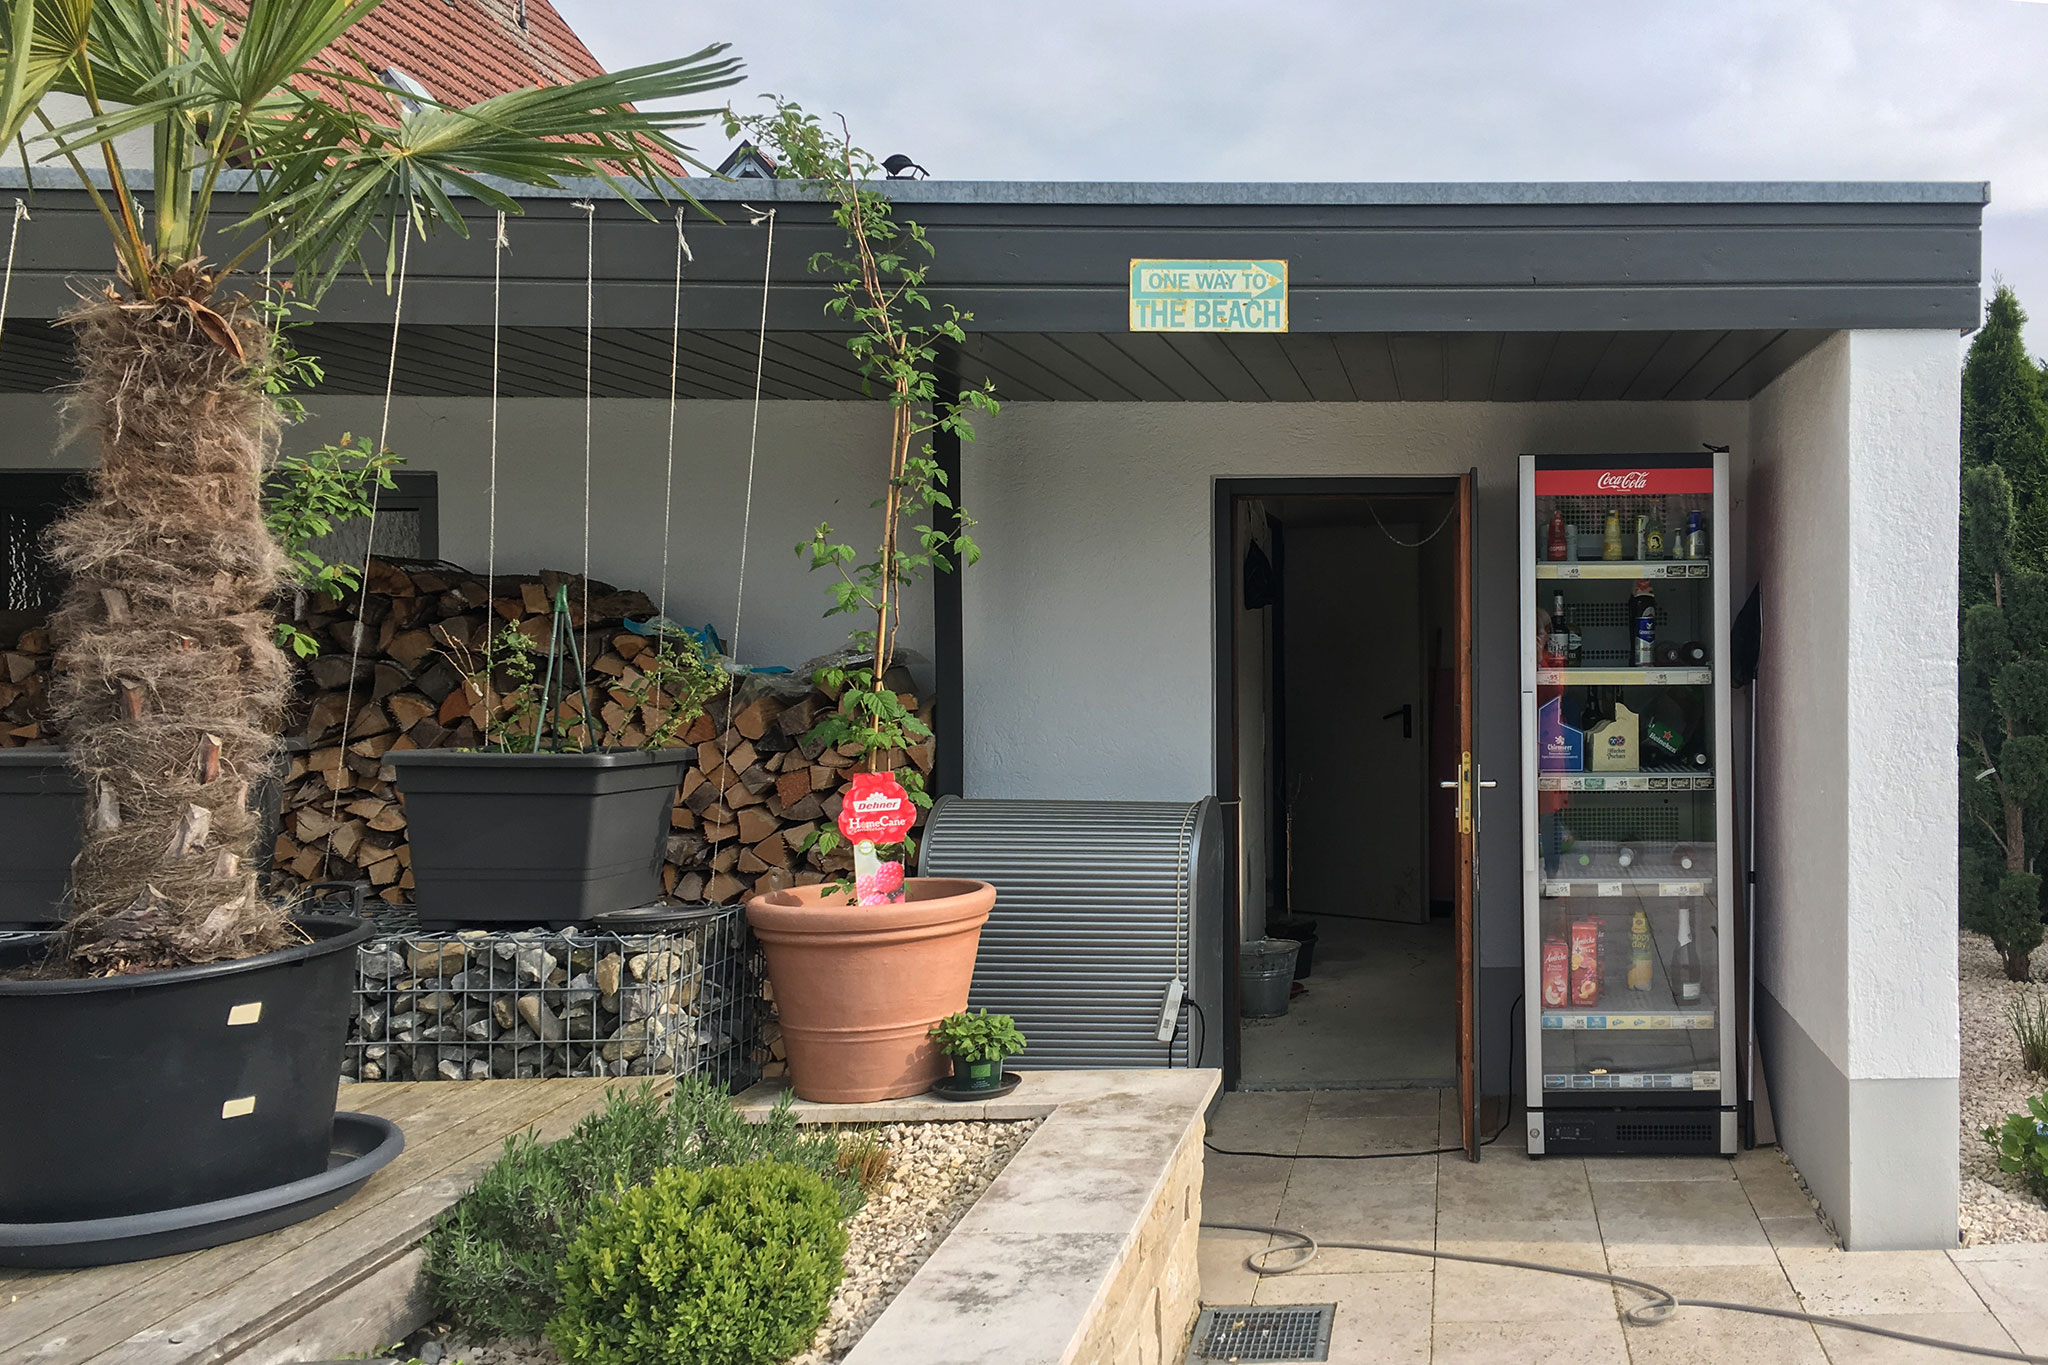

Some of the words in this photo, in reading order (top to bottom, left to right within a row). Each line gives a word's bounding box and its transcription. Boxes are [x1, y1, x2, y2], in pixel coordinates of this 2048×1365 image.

[1148, 273, 1190, 290] ONE
[1195, 273, 1238, 290] WAY
[1241, 273, 1267, 290] TO
[1135, 300, 1186, 328] THE
[1194, 300, 1281, 328] BEACH
[1597, 471, 1650, 489] Coca-Cola
[1649, 732, 1678, 754] Heineken
[858, 801, 898, 811] Dehner
